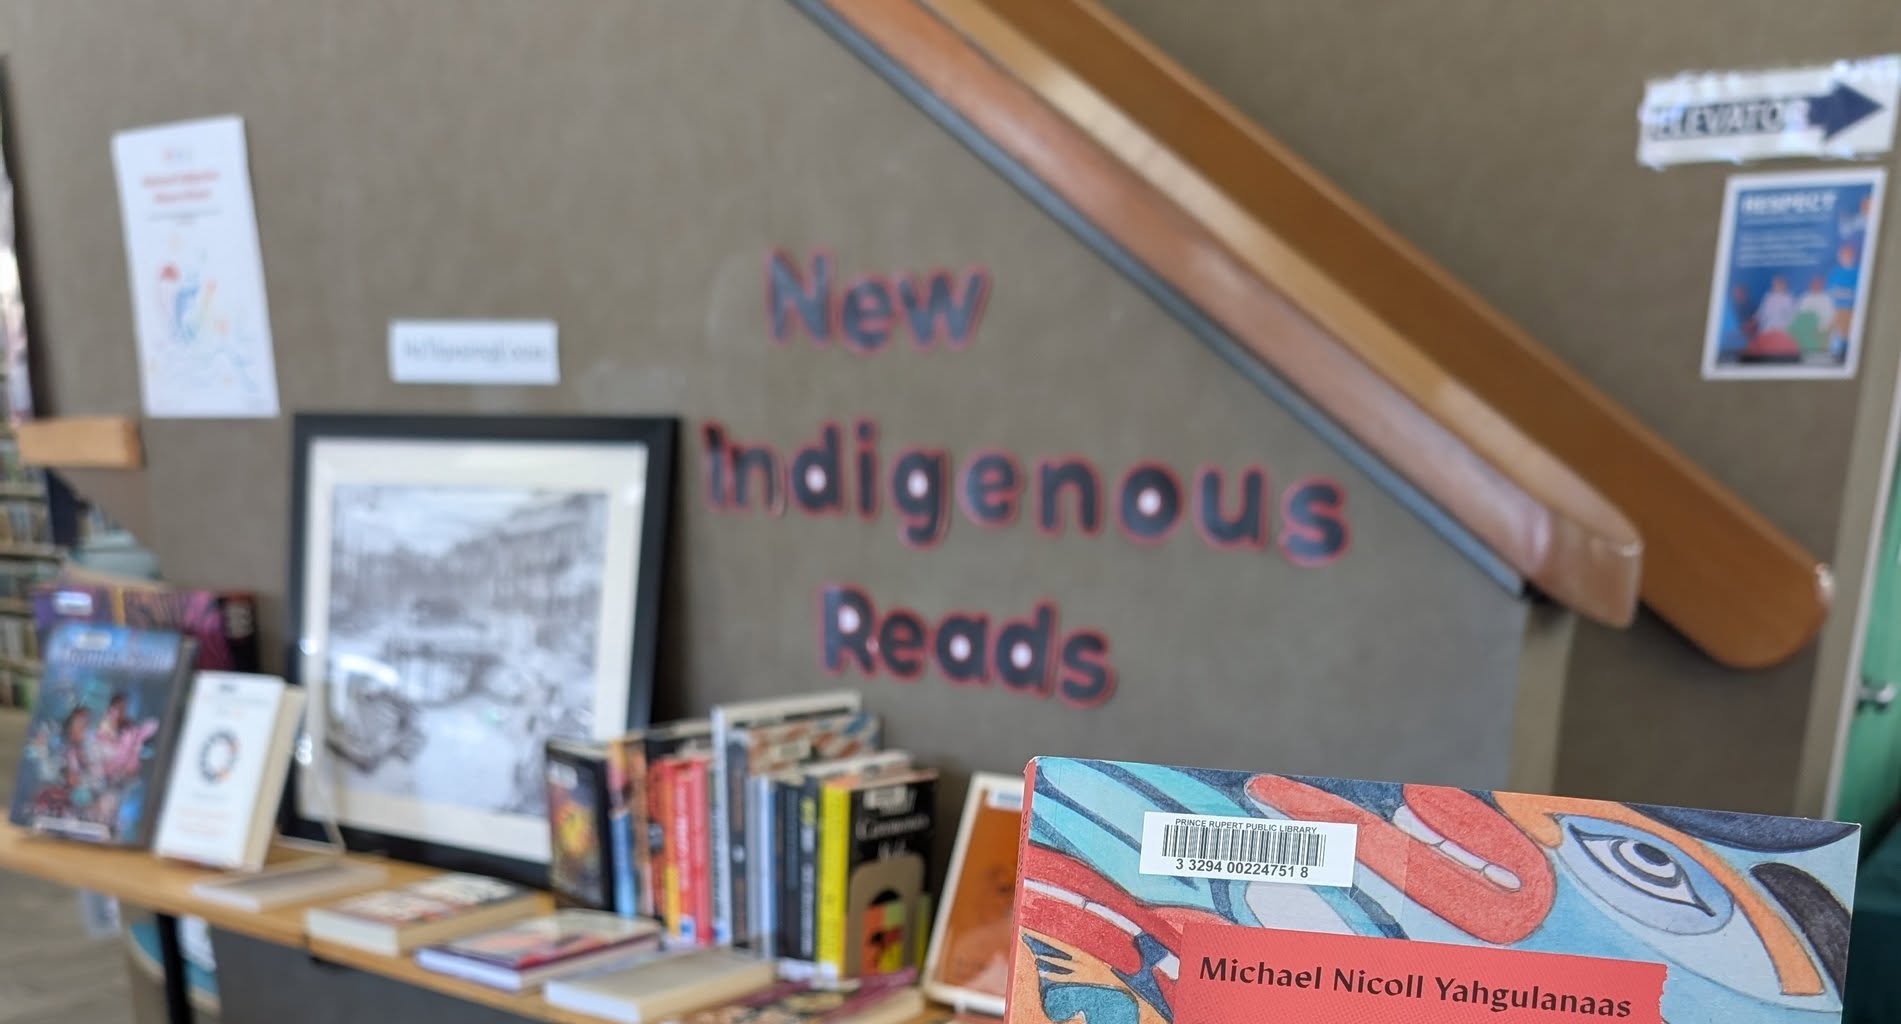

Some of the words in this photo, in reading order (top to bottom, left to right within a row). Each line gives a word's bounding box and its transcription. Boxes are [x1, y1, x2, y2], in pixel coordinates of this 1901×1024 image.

[765, 249, 991, 350] New
[701, 417, 1351, 566] Indigenous
[816, 584, 1118, 708] Reads
[1175, 818, 1207, 827] PRINCE
[1209, 820, 1243, 829] RUPERT
[1245, 823, 1277, 832] PUBLIC
[1279, 825, 1317, 834] LIBRARY
[1175, 858, 1184, 870] 3
[1188, 859, 1222, 873] 3294
[1226, 861, 1294, 878] 00224751
[1300, 866, 1309, 878] 8
[1199, 956, 1322, 990] Michael
[1333, 967, 1424, 999] Nicoll
[1435, 976, 1632, 1019] Yahgulanaas
